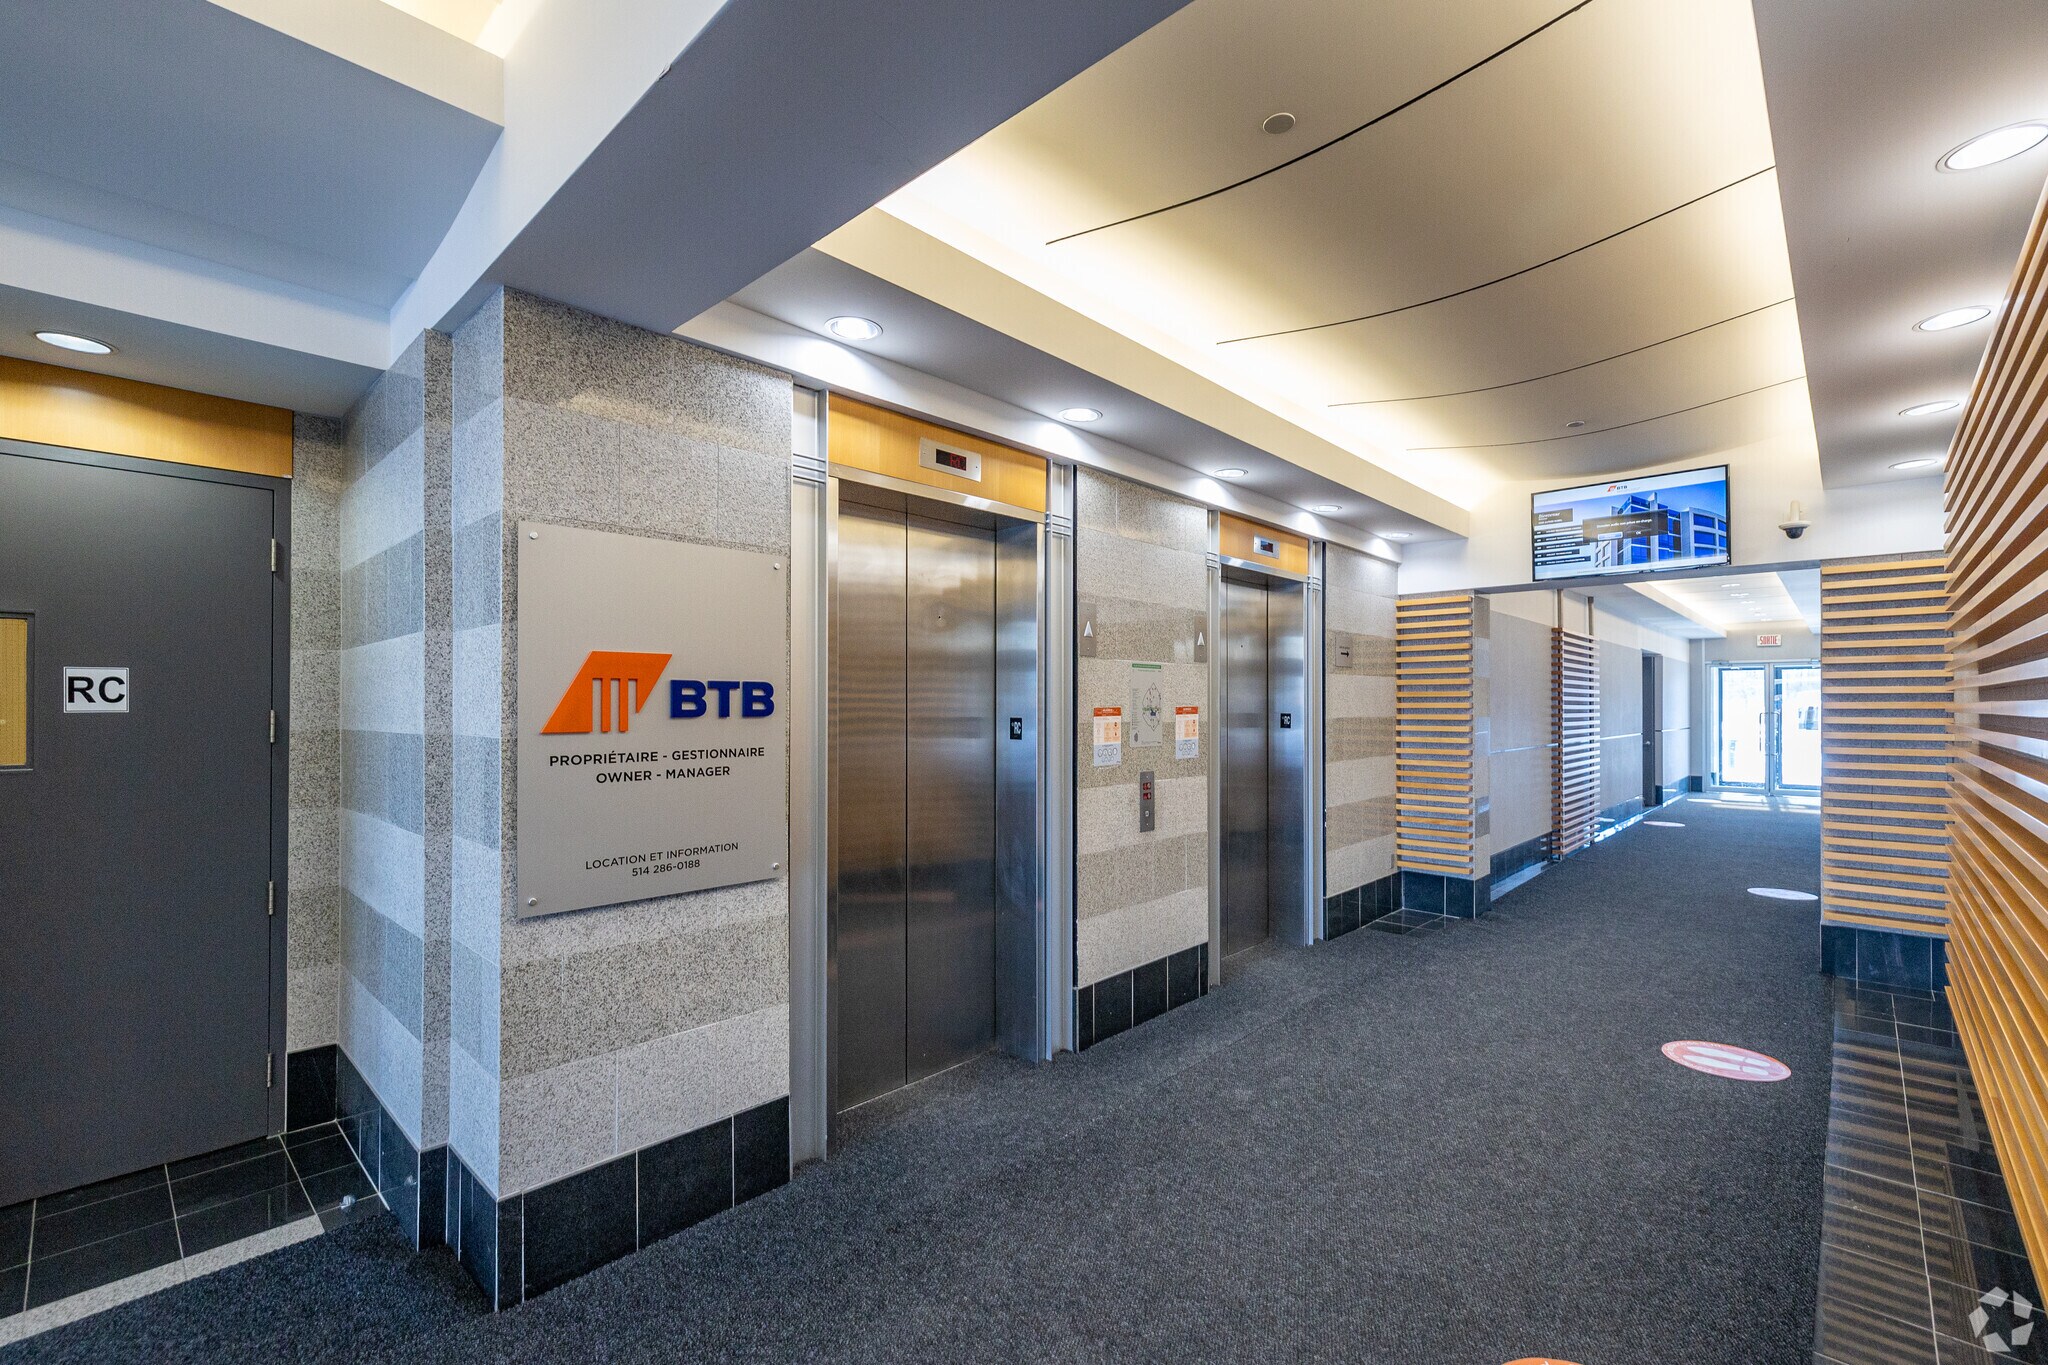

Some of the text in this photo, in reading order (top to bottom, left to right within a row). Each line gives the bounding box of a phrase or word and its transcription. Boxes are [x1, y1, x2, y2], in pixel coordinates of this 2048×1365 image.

[1759, 635, 1778, 645] SORTIE
[68, 676, 125, 703] RC
[670, 679, 775, 719] BTB
[549, 750, 659, 767] PROPRIÉTAIRE
[672, 747, 765, 760] GESTIONNAIRE
[596, 770, 652, 784] OWNER
[666, 766, 731, 779] MANAGER
[585, 842, 739, 870] LOCATION ET INFORMATION
[632, 859, 700, 876] 514 286-0188
